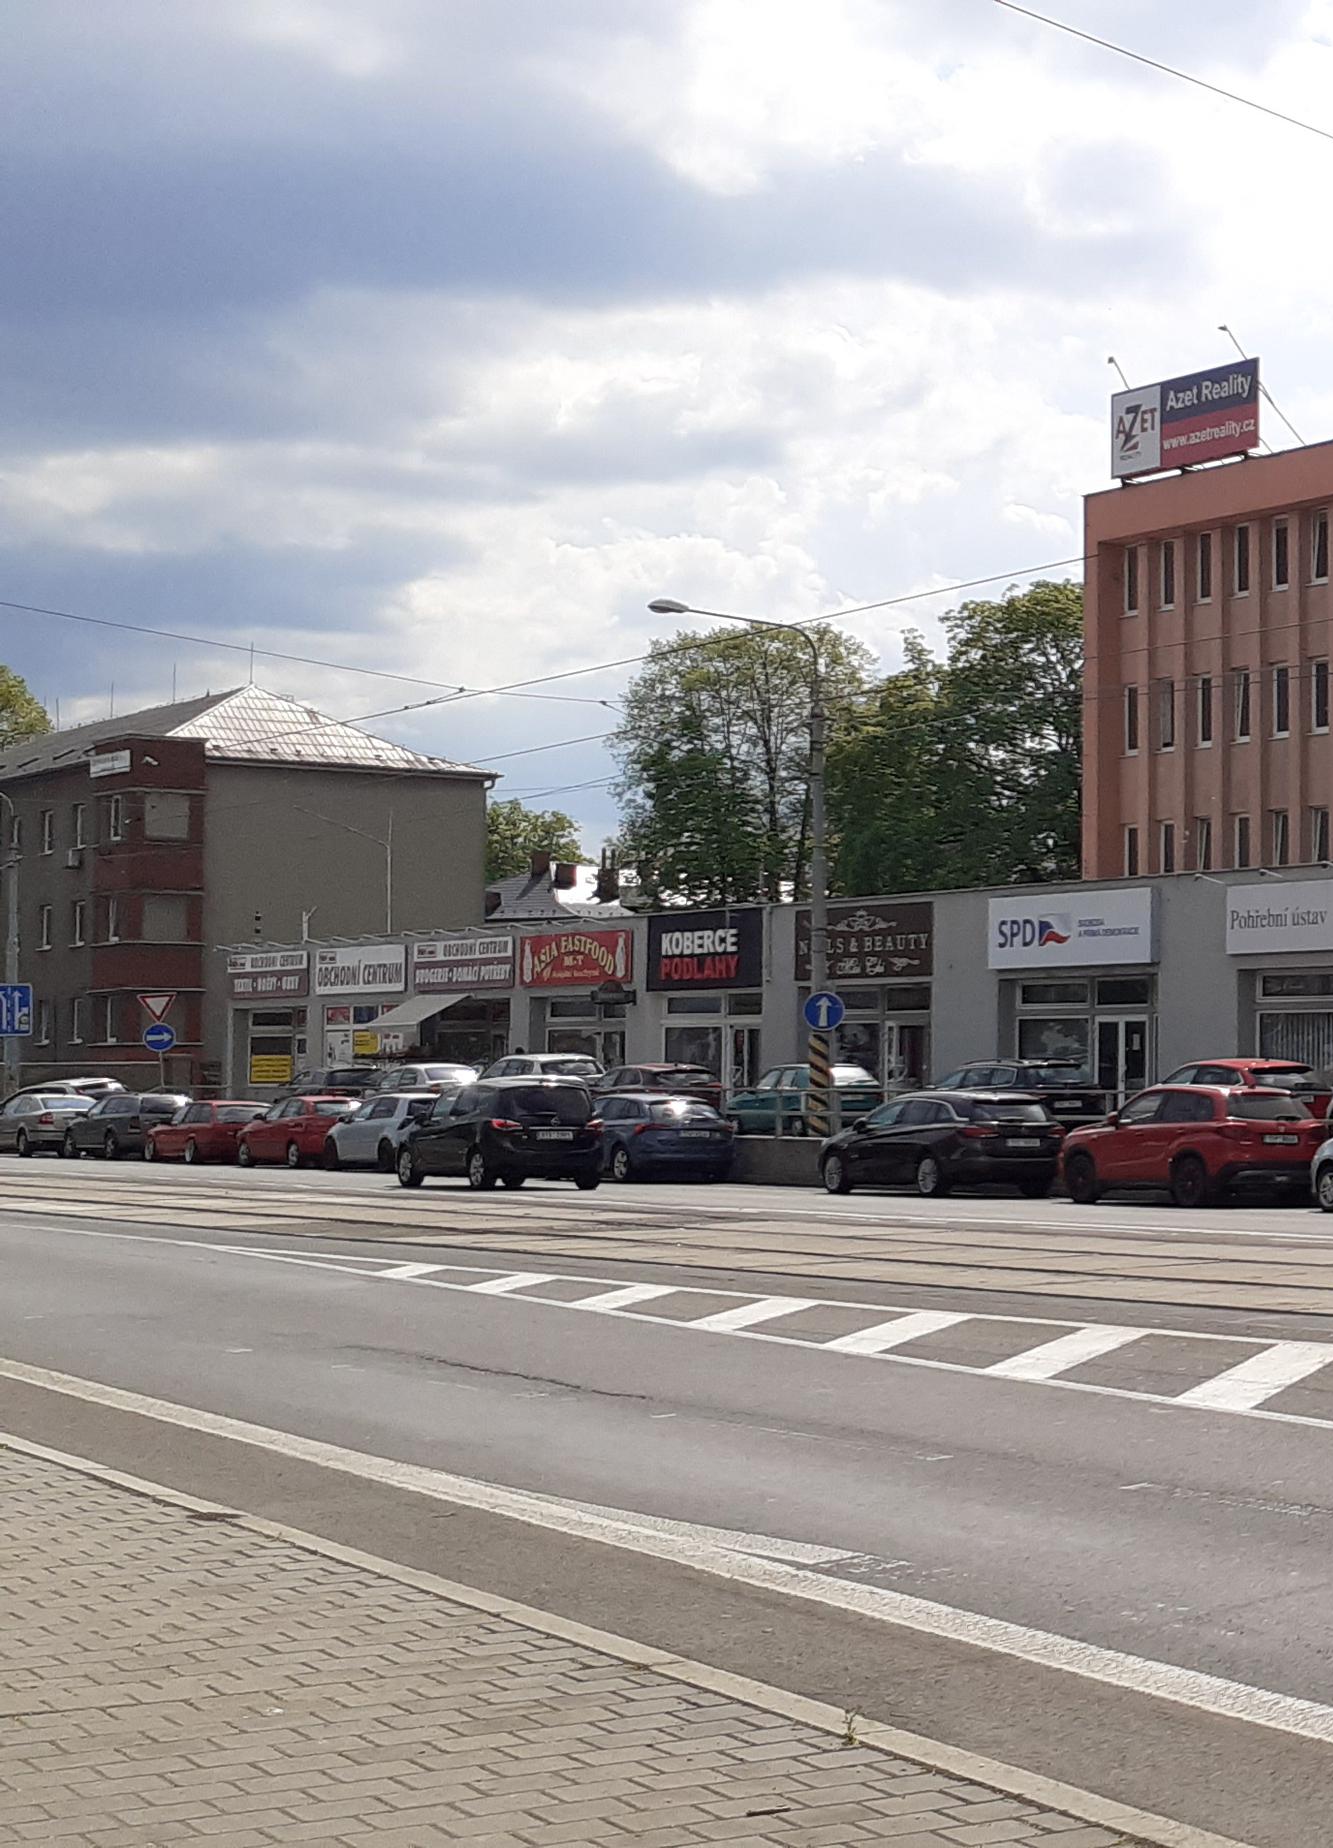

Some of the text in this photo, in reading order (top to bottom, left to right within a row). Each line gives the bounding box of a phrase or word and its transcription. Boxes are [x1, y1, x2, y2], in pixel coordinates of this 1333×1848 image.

[1166, 373, 1251, 412] Azet Reality
[1162, 418, 1256, 450] www.azetreality.cz
[1230, 906, 1328, 931] Pohřební ústav
[661, 928, 739, 956] KOBERCE
[798, 933, 929, 956] NLS & BEAUTY
[998, 918, 1036, 949] SPD
[533, 935, 615, 979] ASIA FASTFOOD
[660, 954, 739, 980] PODLAHY
[317, 960, 361, 987] OBCHODNÍ
[362, 962, 402, 985] CENTRUM
